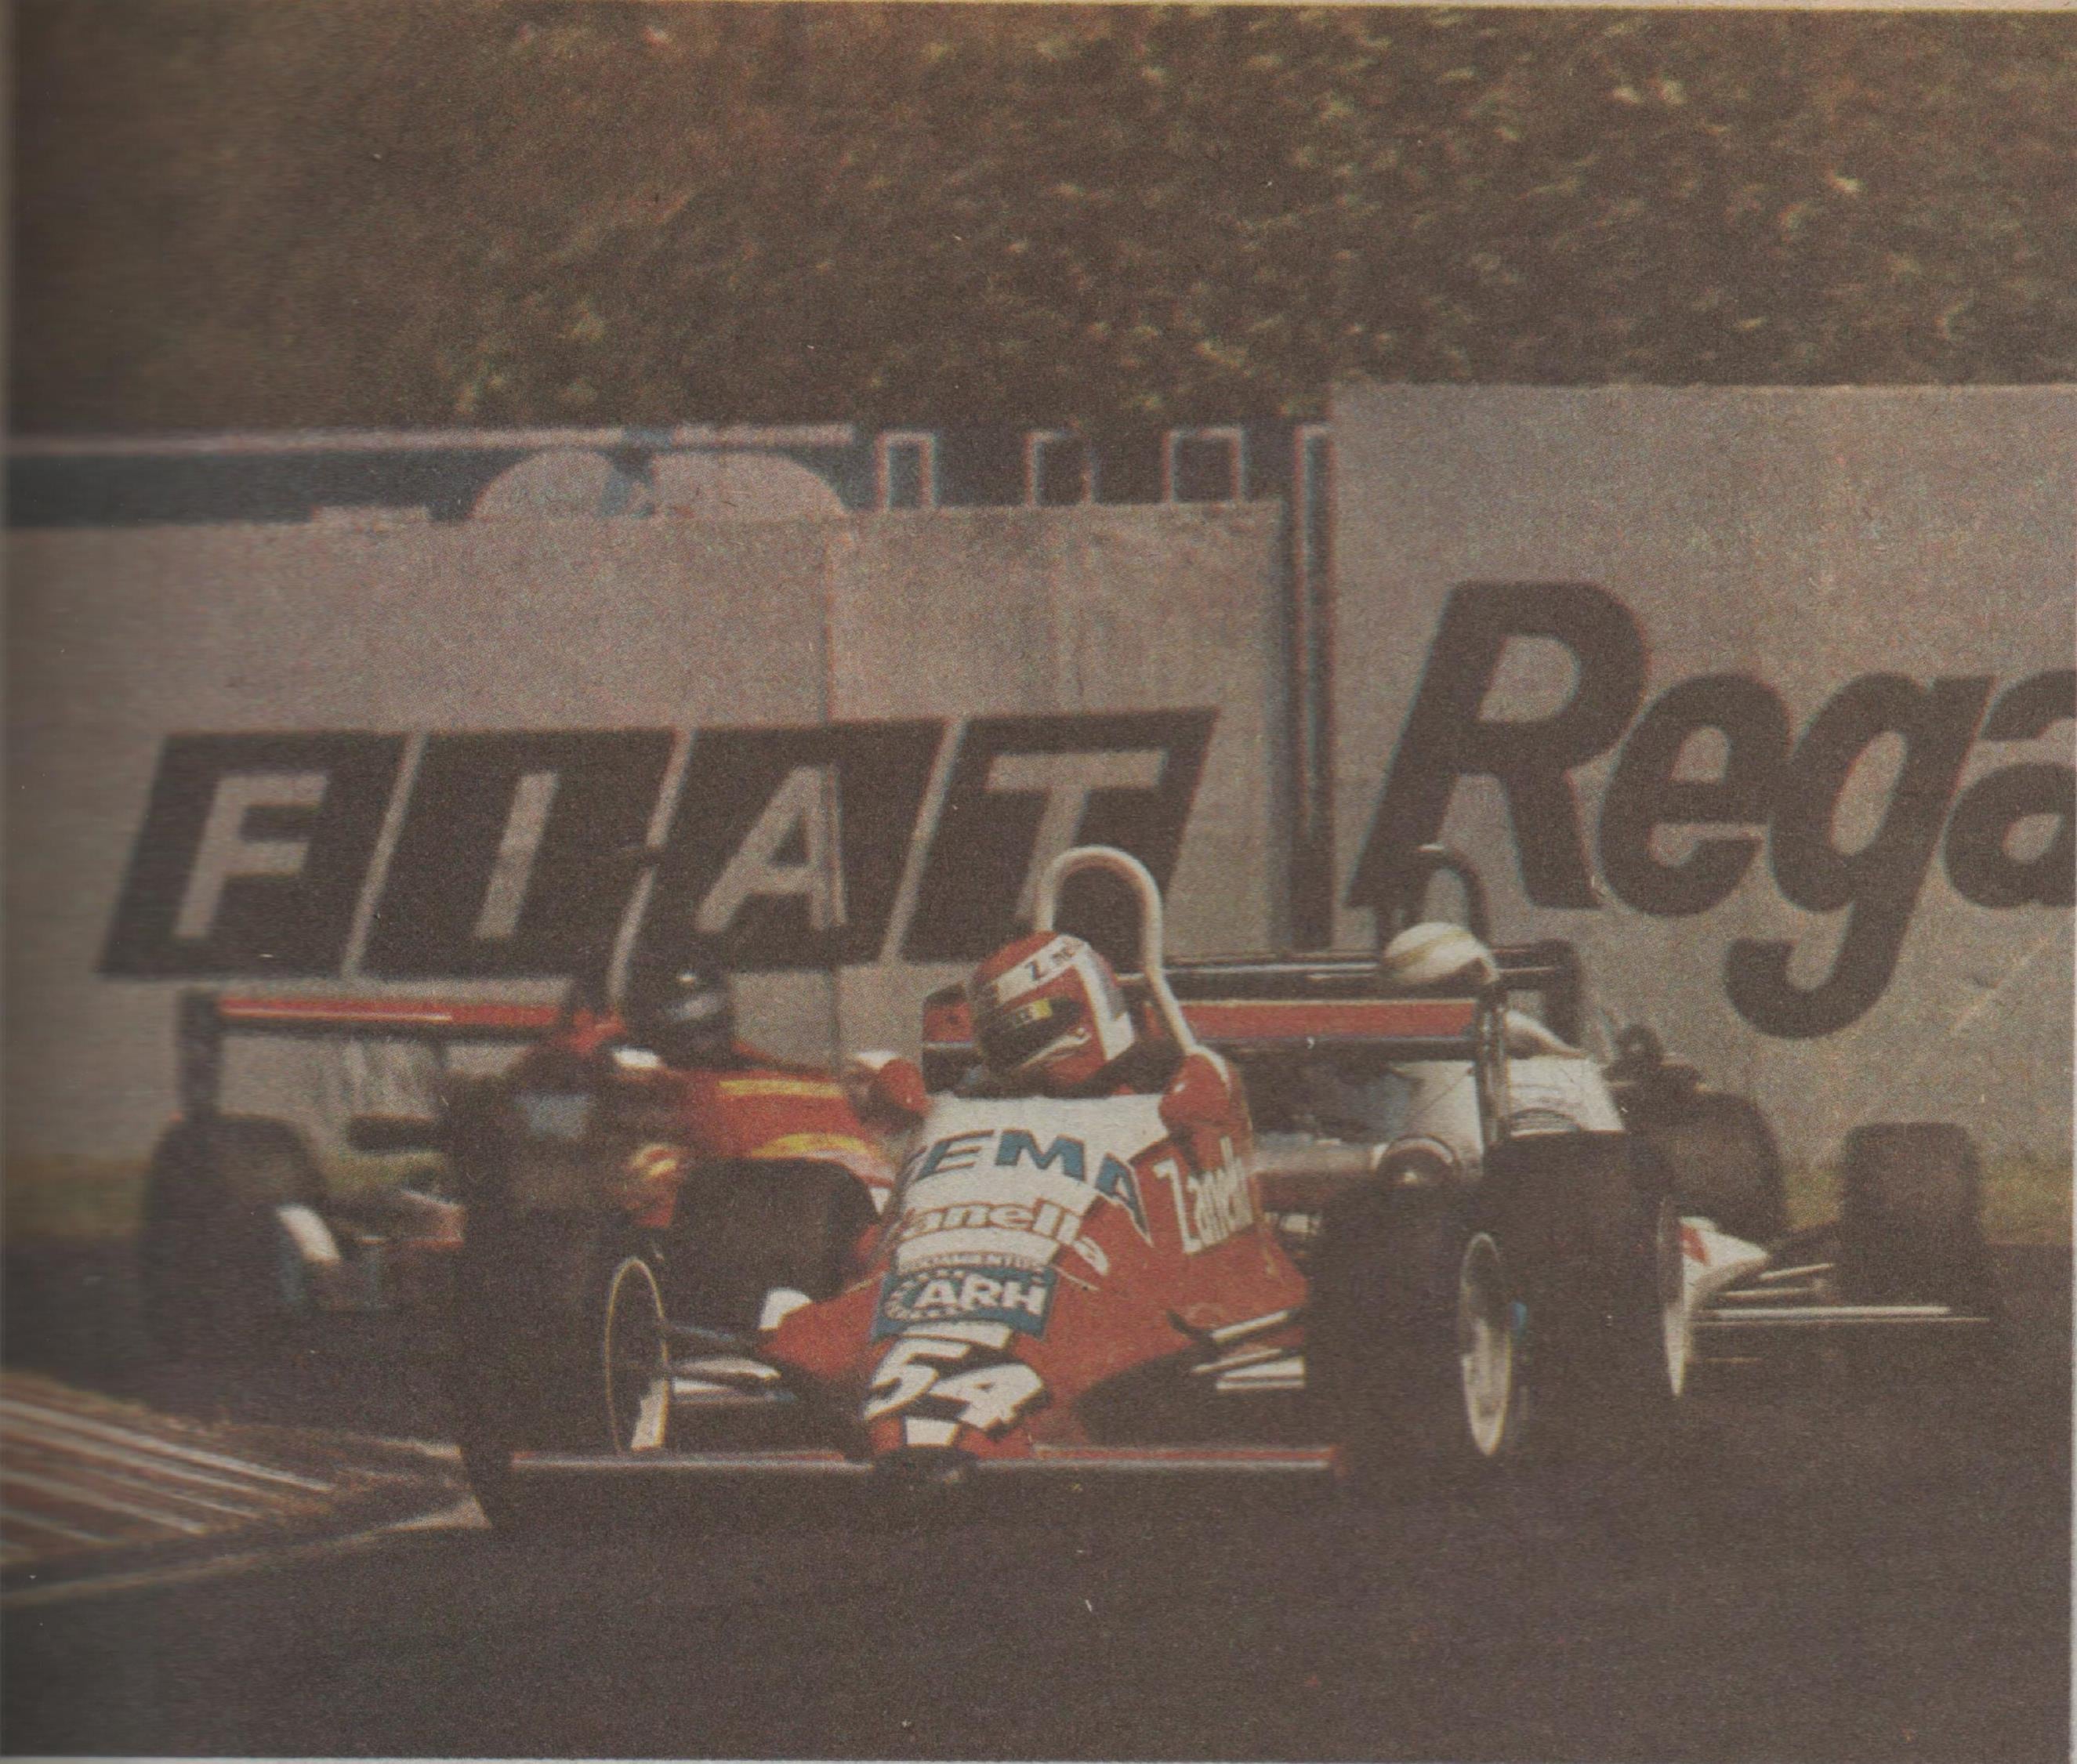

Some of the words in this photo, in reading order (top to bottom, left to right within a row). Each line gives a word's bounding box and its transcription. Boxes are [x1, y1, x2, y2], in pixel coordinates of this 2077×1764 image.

[172, 744, 1171, 940] FIAT
[1342, 580, 2076, 1039] Rega
[863, 1337, 1045, 1430] 54
